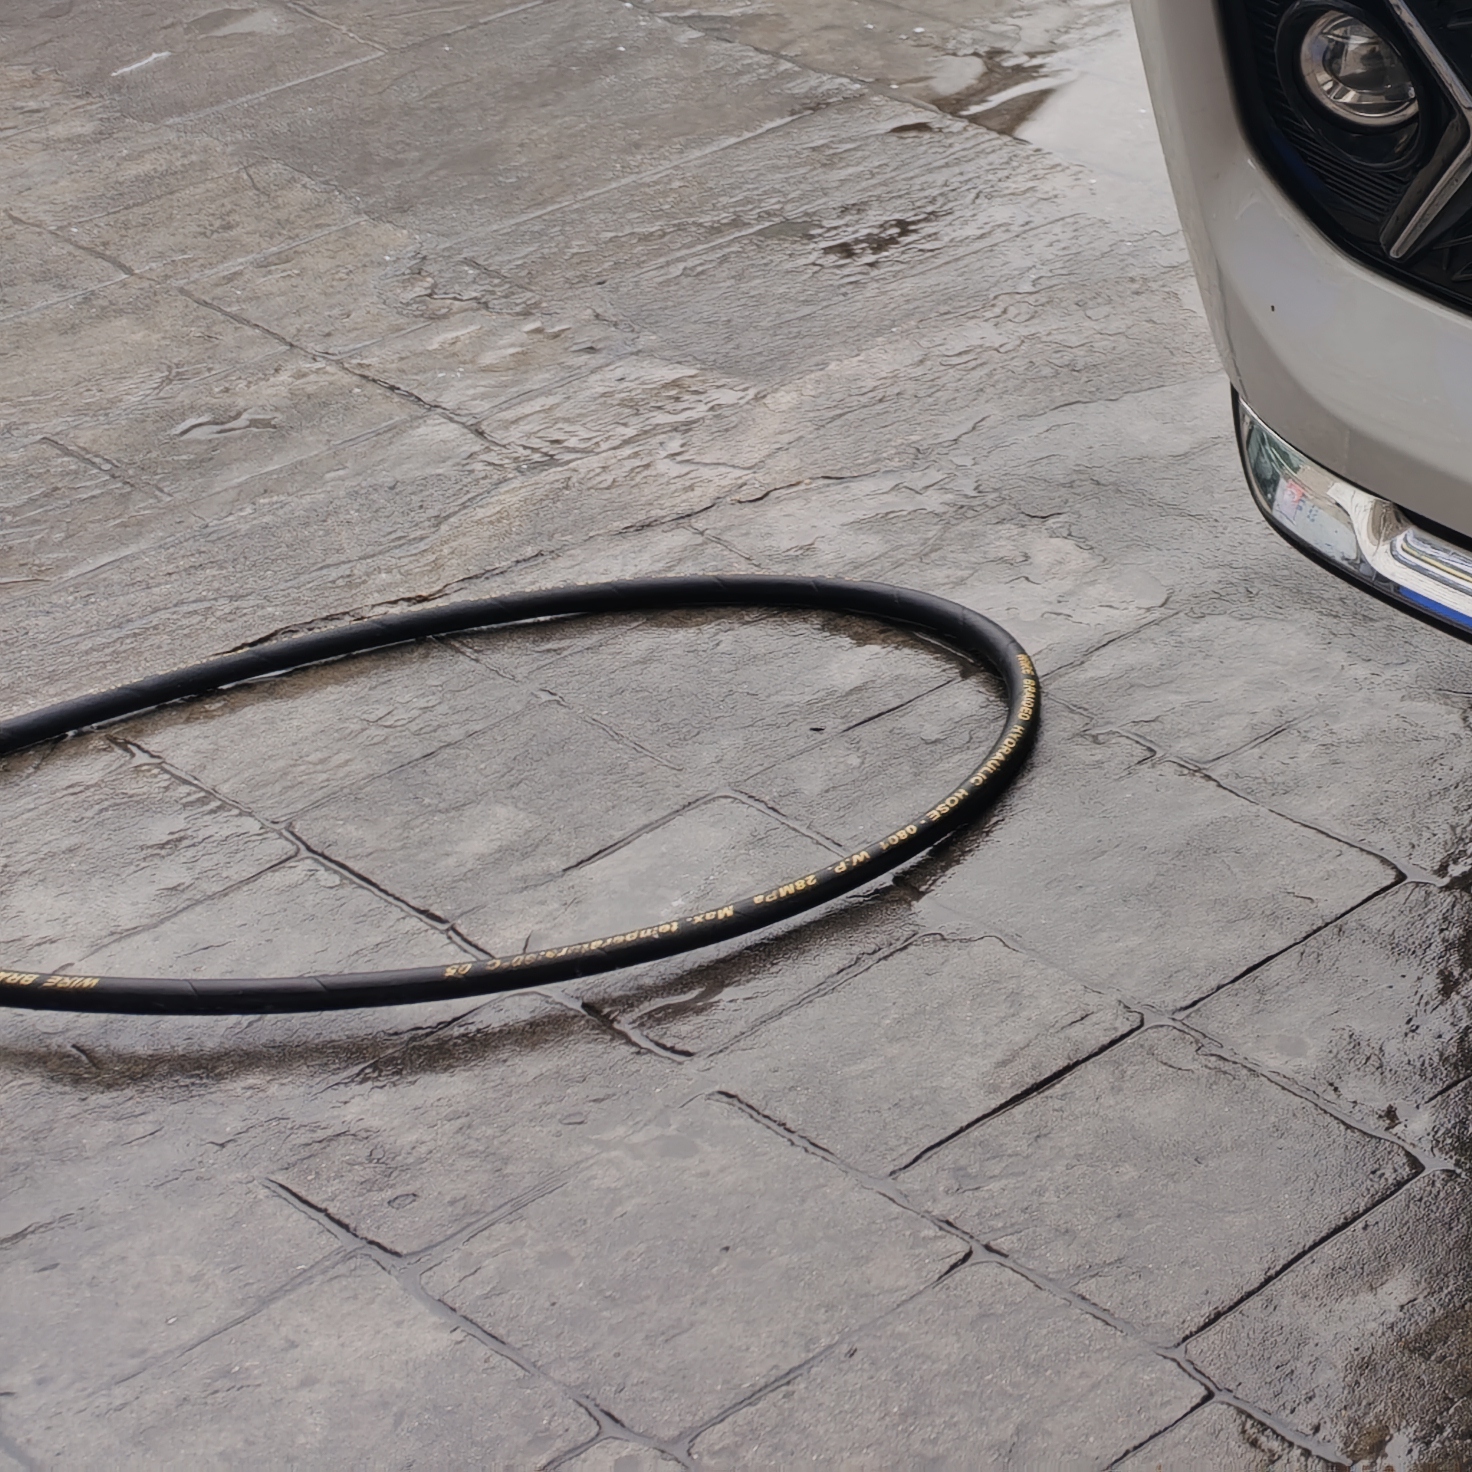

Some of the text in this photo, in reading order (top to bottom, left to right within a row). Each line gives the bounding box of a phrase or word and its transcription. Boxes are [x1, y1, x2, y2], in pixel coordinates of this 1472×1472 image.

[1017, 678, 1038, 722] BRAIDED
[969, 725, 1025, 787] HYDRAULIC
[925, 787, 970, 822] HOSE
[752, 873, 819, 906] 28MPa
[43, 975, 101, 988] WIRE
